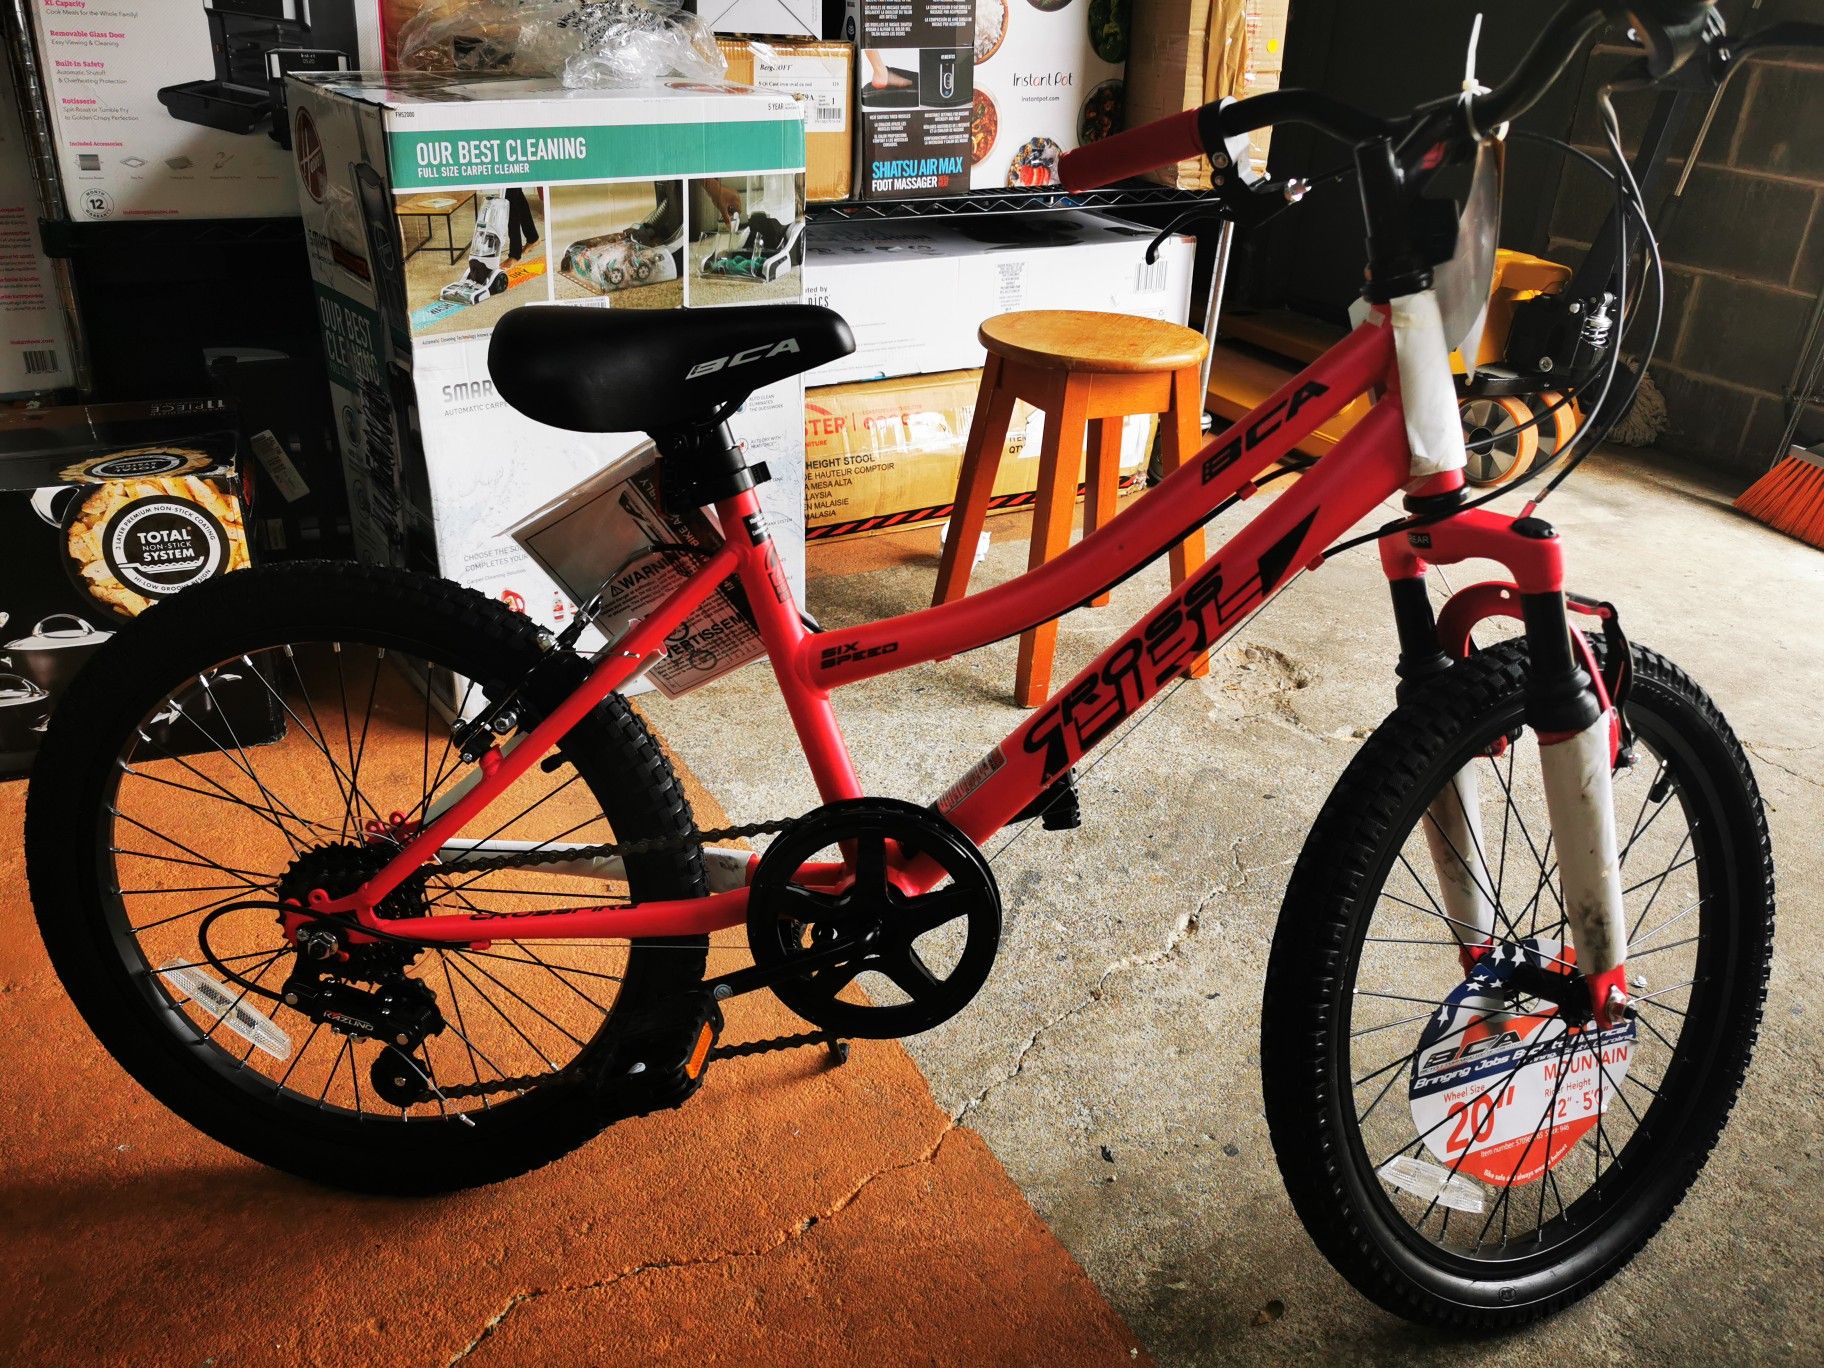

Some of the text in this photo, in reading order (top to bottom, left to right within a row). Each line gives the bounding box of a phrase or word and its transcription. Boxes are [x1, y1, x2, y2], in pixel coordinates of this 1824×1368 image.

[55, 0, 85, 8] Capacity
[1013, 72, 1073, 87] Instant Pot
[416, 136, 587, 165] OUR BEST CLEANING
[418, 163, 530, 178] FULL SIZE CARPET CLEANER
[872, 156, 963, 179] SHIATSU AIR MAX
[872, 179, 892, 192] FOOT
[894, 176, 937, 190] MASSAGER
[89, 198, 104, 210] 12
[509, 268, 529, 279] DRY
[320, 296, 373, 352] OUR BEST
[685, 337, 800, 380] BCA
[445, 405, 484, 416] AUTOMATIC
[1200, 380, 1330, 486] BCA
[806, 454, 876, 469] HEIGHT STOOL
[815, 469, 852, 479] HAUTEUR
[854, 462, 895, 474] COMPTOIR
[810, 481, 833, 489] MESA
[814, 498, 849, 509] MALAISIE
[805, 510, 836, 519] MALASIA
[117, 526, 125, 545] LAYER
[125, 509, 152, 527] PREMIUM
[154, 506, 193, 517] NON-STICK
[194, 516, 216, 541] COATING
[137, 528, 191, 544] TOTAL
[142, 541, 192, 551] NON-STICK
[144, 548, 195, 561] SYSTEM
[464, 551, 493, 562] CHOOSE
[465, 558, 508, 572] COMPLETES
[134, 576, 158, 590] HI-LOW
[820, 642, 898, 669] SPEED
[821, 641, 859, 659] SIX
[1414, 1066, 1471, 1090] Bringing
[1475, 1056, 1510, 1071] Jobs
[1443, 1084, 1485, 1103] Wheel Size
[1544, 1078, 1591, 1097] Rir Height
[1481, 1149, 1493, 1158] Item
[1484, 1169, 1495, 1178] Bike
